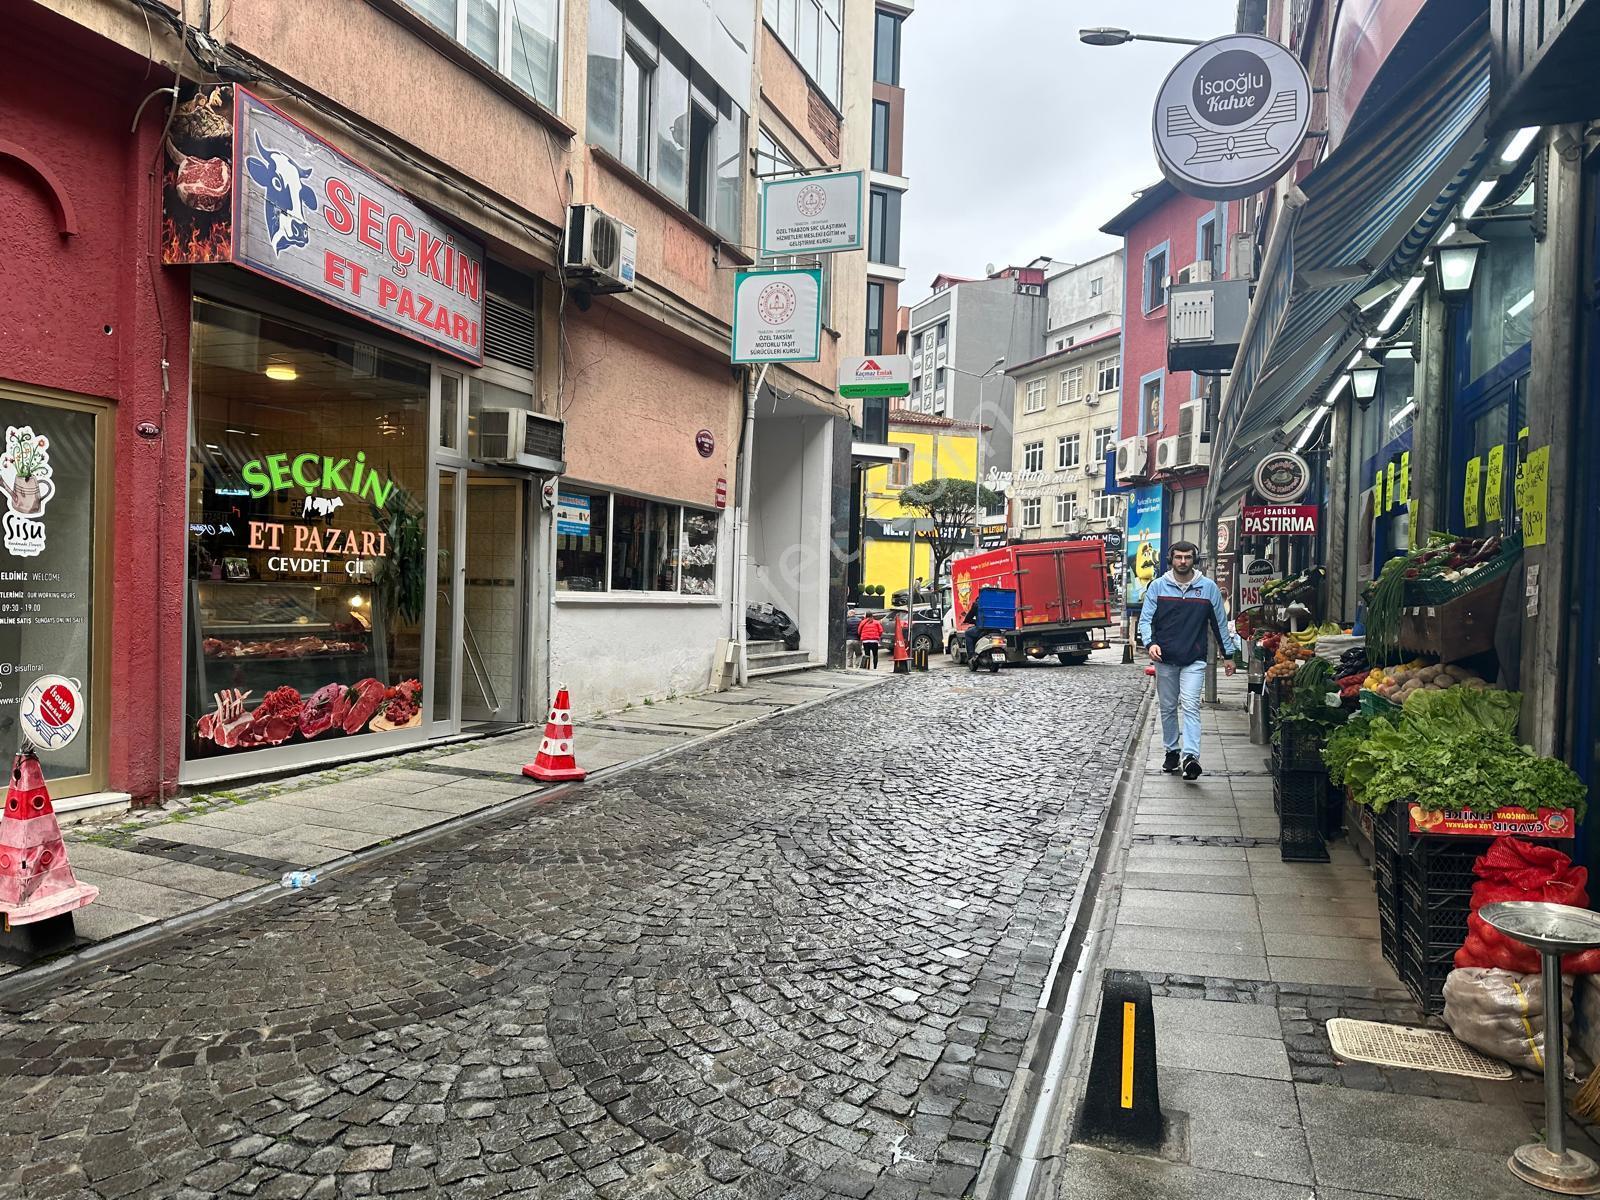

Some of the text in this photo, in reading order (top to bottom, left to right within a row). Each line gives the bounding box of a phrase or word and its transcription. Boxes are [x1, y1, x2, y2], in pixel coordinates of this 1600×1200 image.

[1200, 73, 1264, 95] İsaoğlu
[1206, 95, 1256, 112] Kahve
[322, 177, 480, 303] SEÇKİN
[323, 250, 478, 349] ET PAZARI
[242, 450, 393, 509] SEÇKİN
[1263, 507, 1296, 515] İSAOĞLU
[7, 515, 42, 540] Sisu
[1244, 517, 1315, 532] PASTIRMA
[248, 521, 284, 550] ET
[294, 525, 387, 557] PAZARI
[268, 556, 367, 576] CEVDET ÇİL
[32, 572, 61, 581] WELCOME
[2, 603, 19, 611] 09:30
[25, 603, 41, 611] 19.00
[16, 617, 32, 625] SATIŞ
[14, 664, 44, 672] sisufloral
[1446, 821, 1478, 830] PORTAKAL
[1494, 821, 1544, 833] ÇAVDIR
